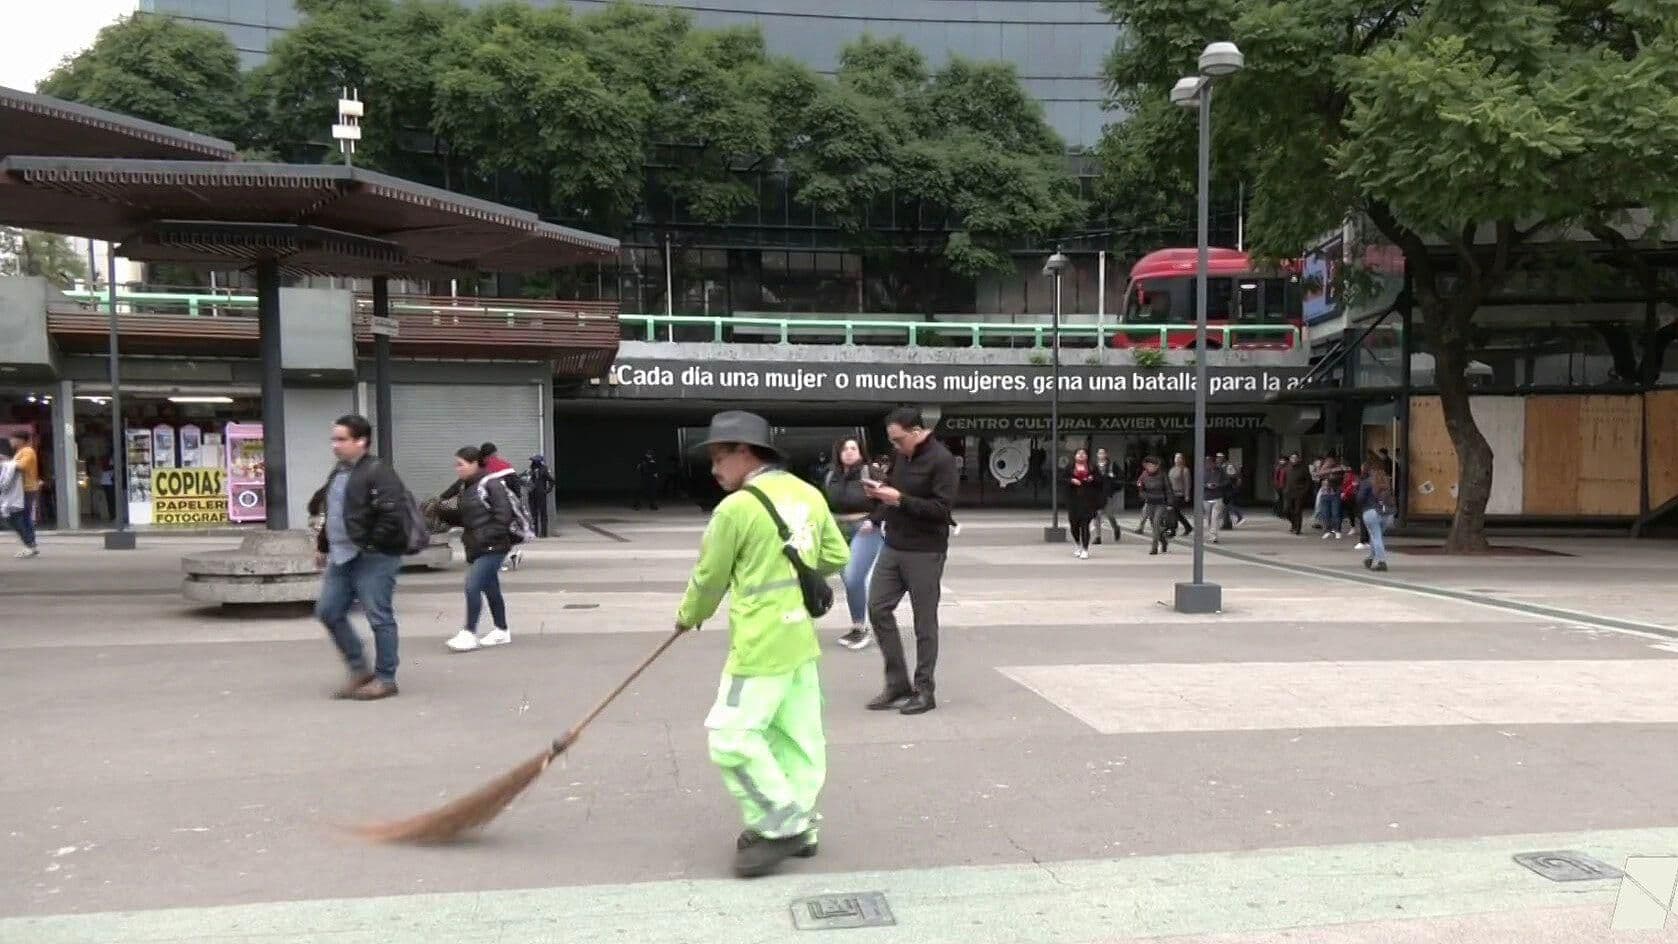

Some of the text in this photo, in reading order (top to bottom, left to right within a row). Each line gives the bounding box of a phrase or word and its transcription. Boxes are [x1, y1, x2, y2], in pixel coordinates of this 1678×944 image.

[681, 366, 714, 386] día
[719, 371, 759, 387] una
[765, 369, 828, 391] mujer
[835, 373, 849, 389] o
[855, 370, 938, 390] muchas
[1033, 375, 1082, 394] gana
[1089, 375, 1127, 391] una
[1132, 372, 1198, 391] batalla
[1210, 375, 1257, 396] para
[1263, 372, 1280, 391] la
[946, 418, 1010, 430] CENTRO
[1014, 418, 1096, 430] CULTURAL
[1100, 417, 1155, 430] XAVIER
[156, 471, 221, 495] COPIAS
